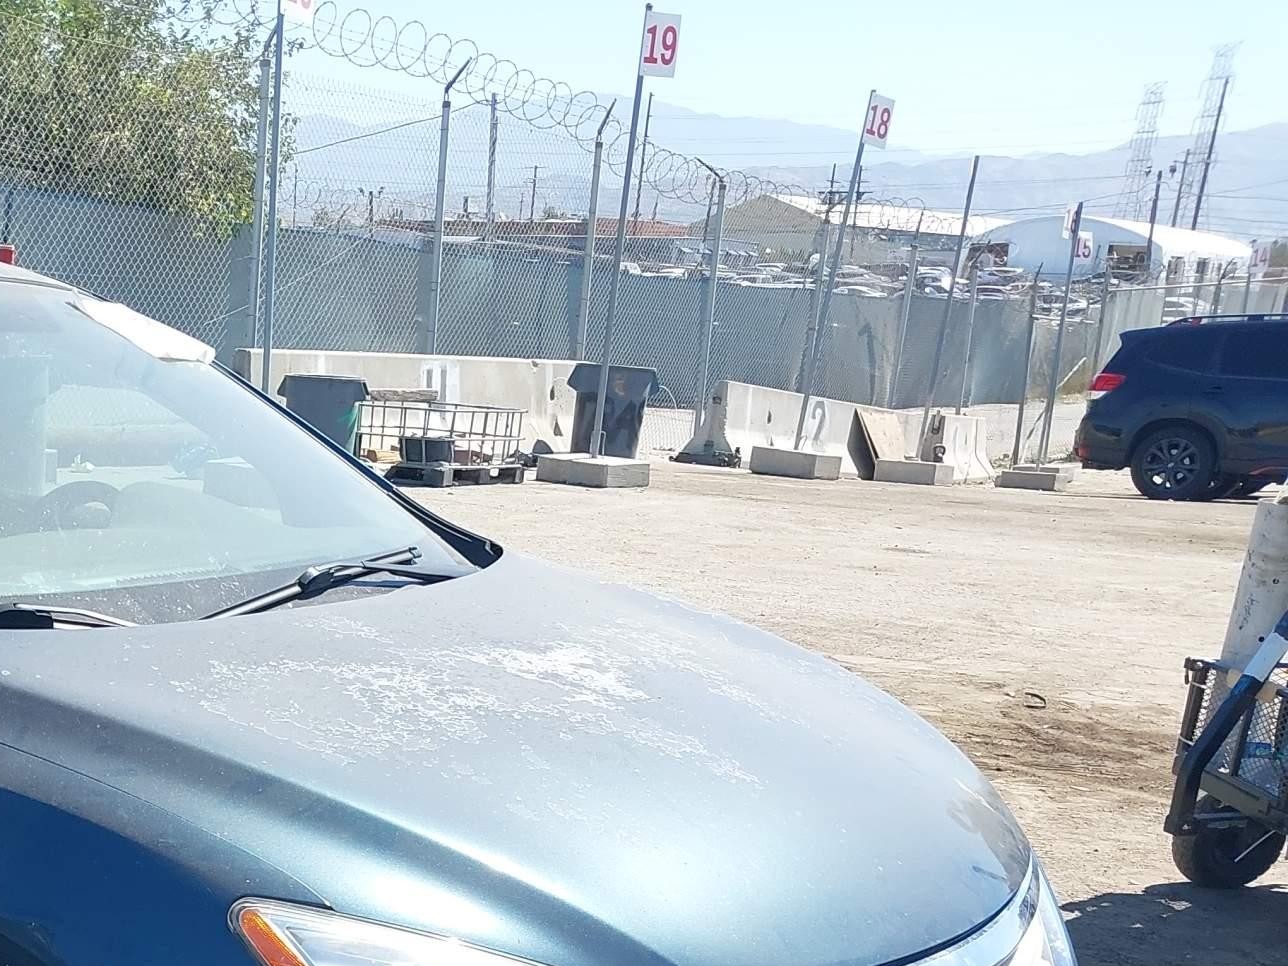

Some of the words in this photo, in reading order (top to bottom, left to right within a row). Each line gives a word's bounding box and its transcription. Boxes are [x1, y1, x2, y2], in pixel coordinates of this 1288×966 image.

[644, 25, 677, 65] 19
[866, 104, 891, 139] 18
[1075, 237, 1091, 258] 15
[1252, 247, 1267, 267] 14
